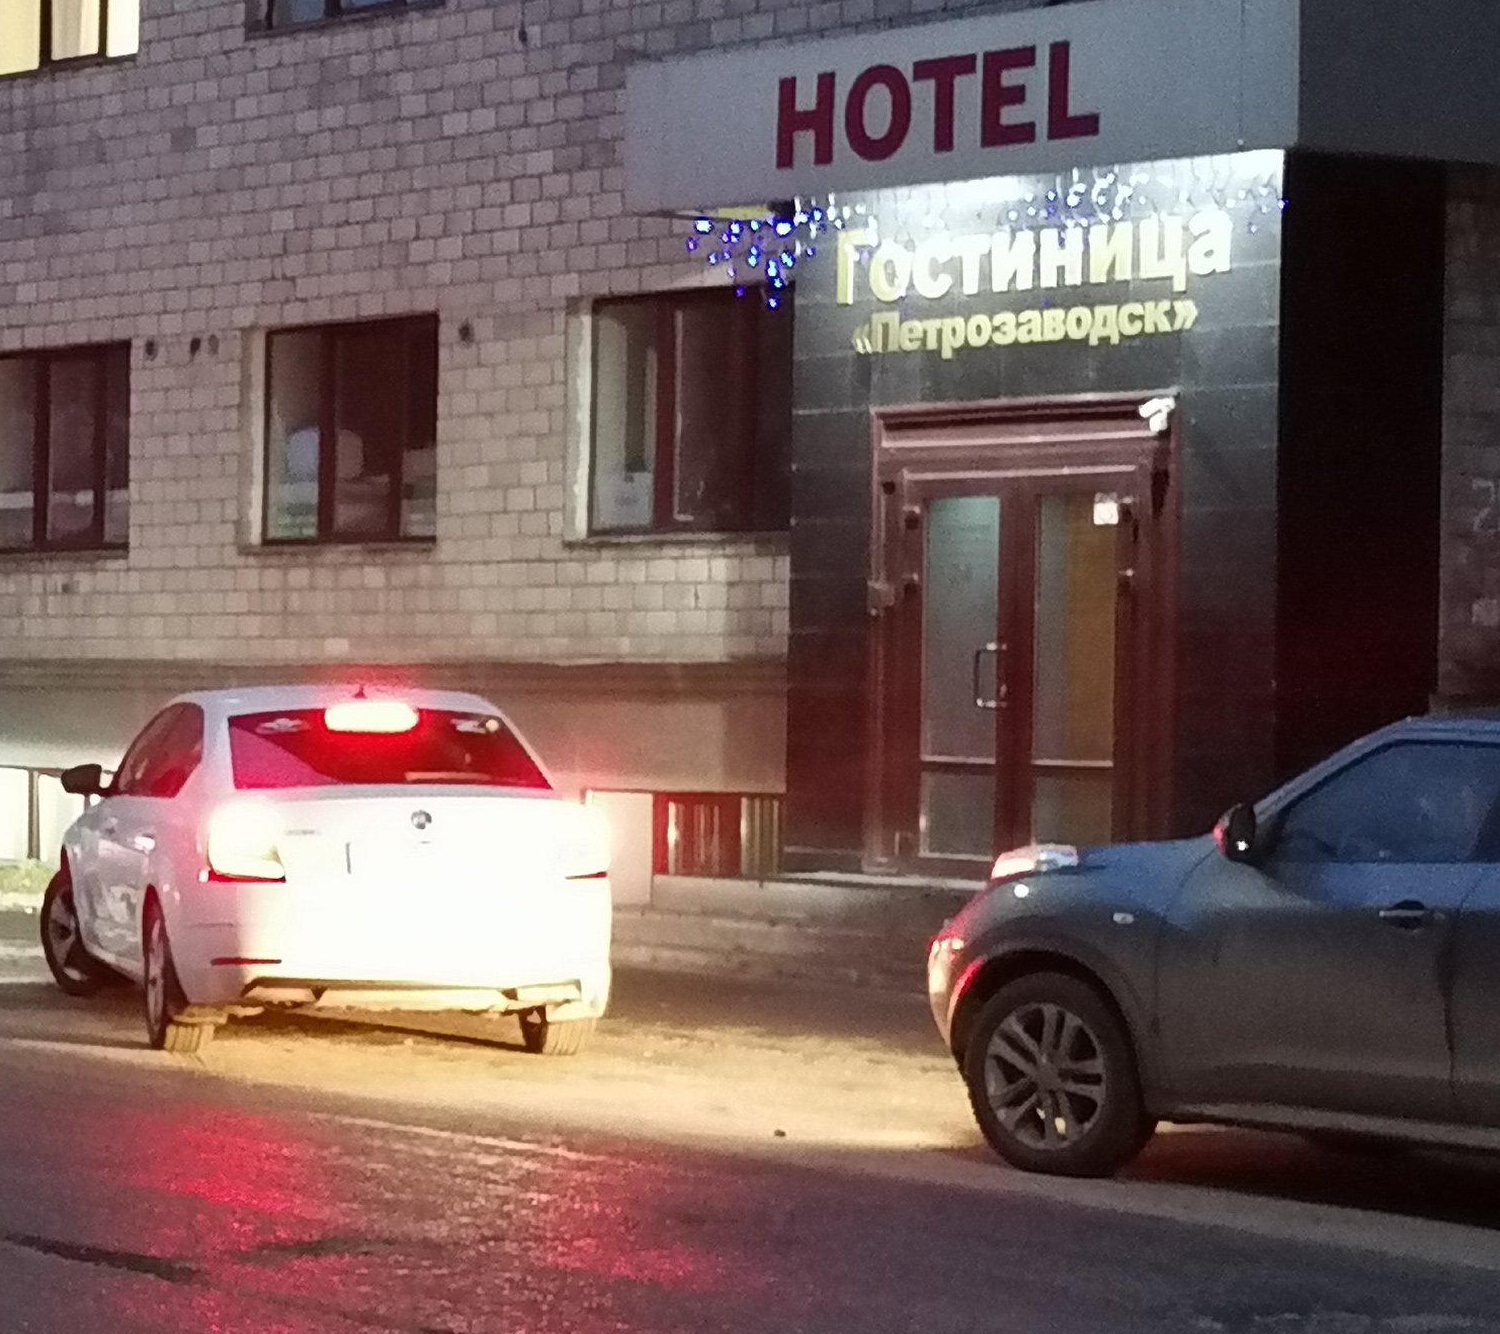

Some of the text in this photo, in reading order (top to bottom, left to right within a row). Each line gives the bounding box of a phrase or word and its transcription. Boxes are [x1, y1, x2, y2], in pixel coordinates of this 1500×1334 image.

[775, 40, 1100, 169] HOTEL
[836, 208, 1233, 305] Гостиница
[852, 299, 1199, 359] «Петрозаводск»
